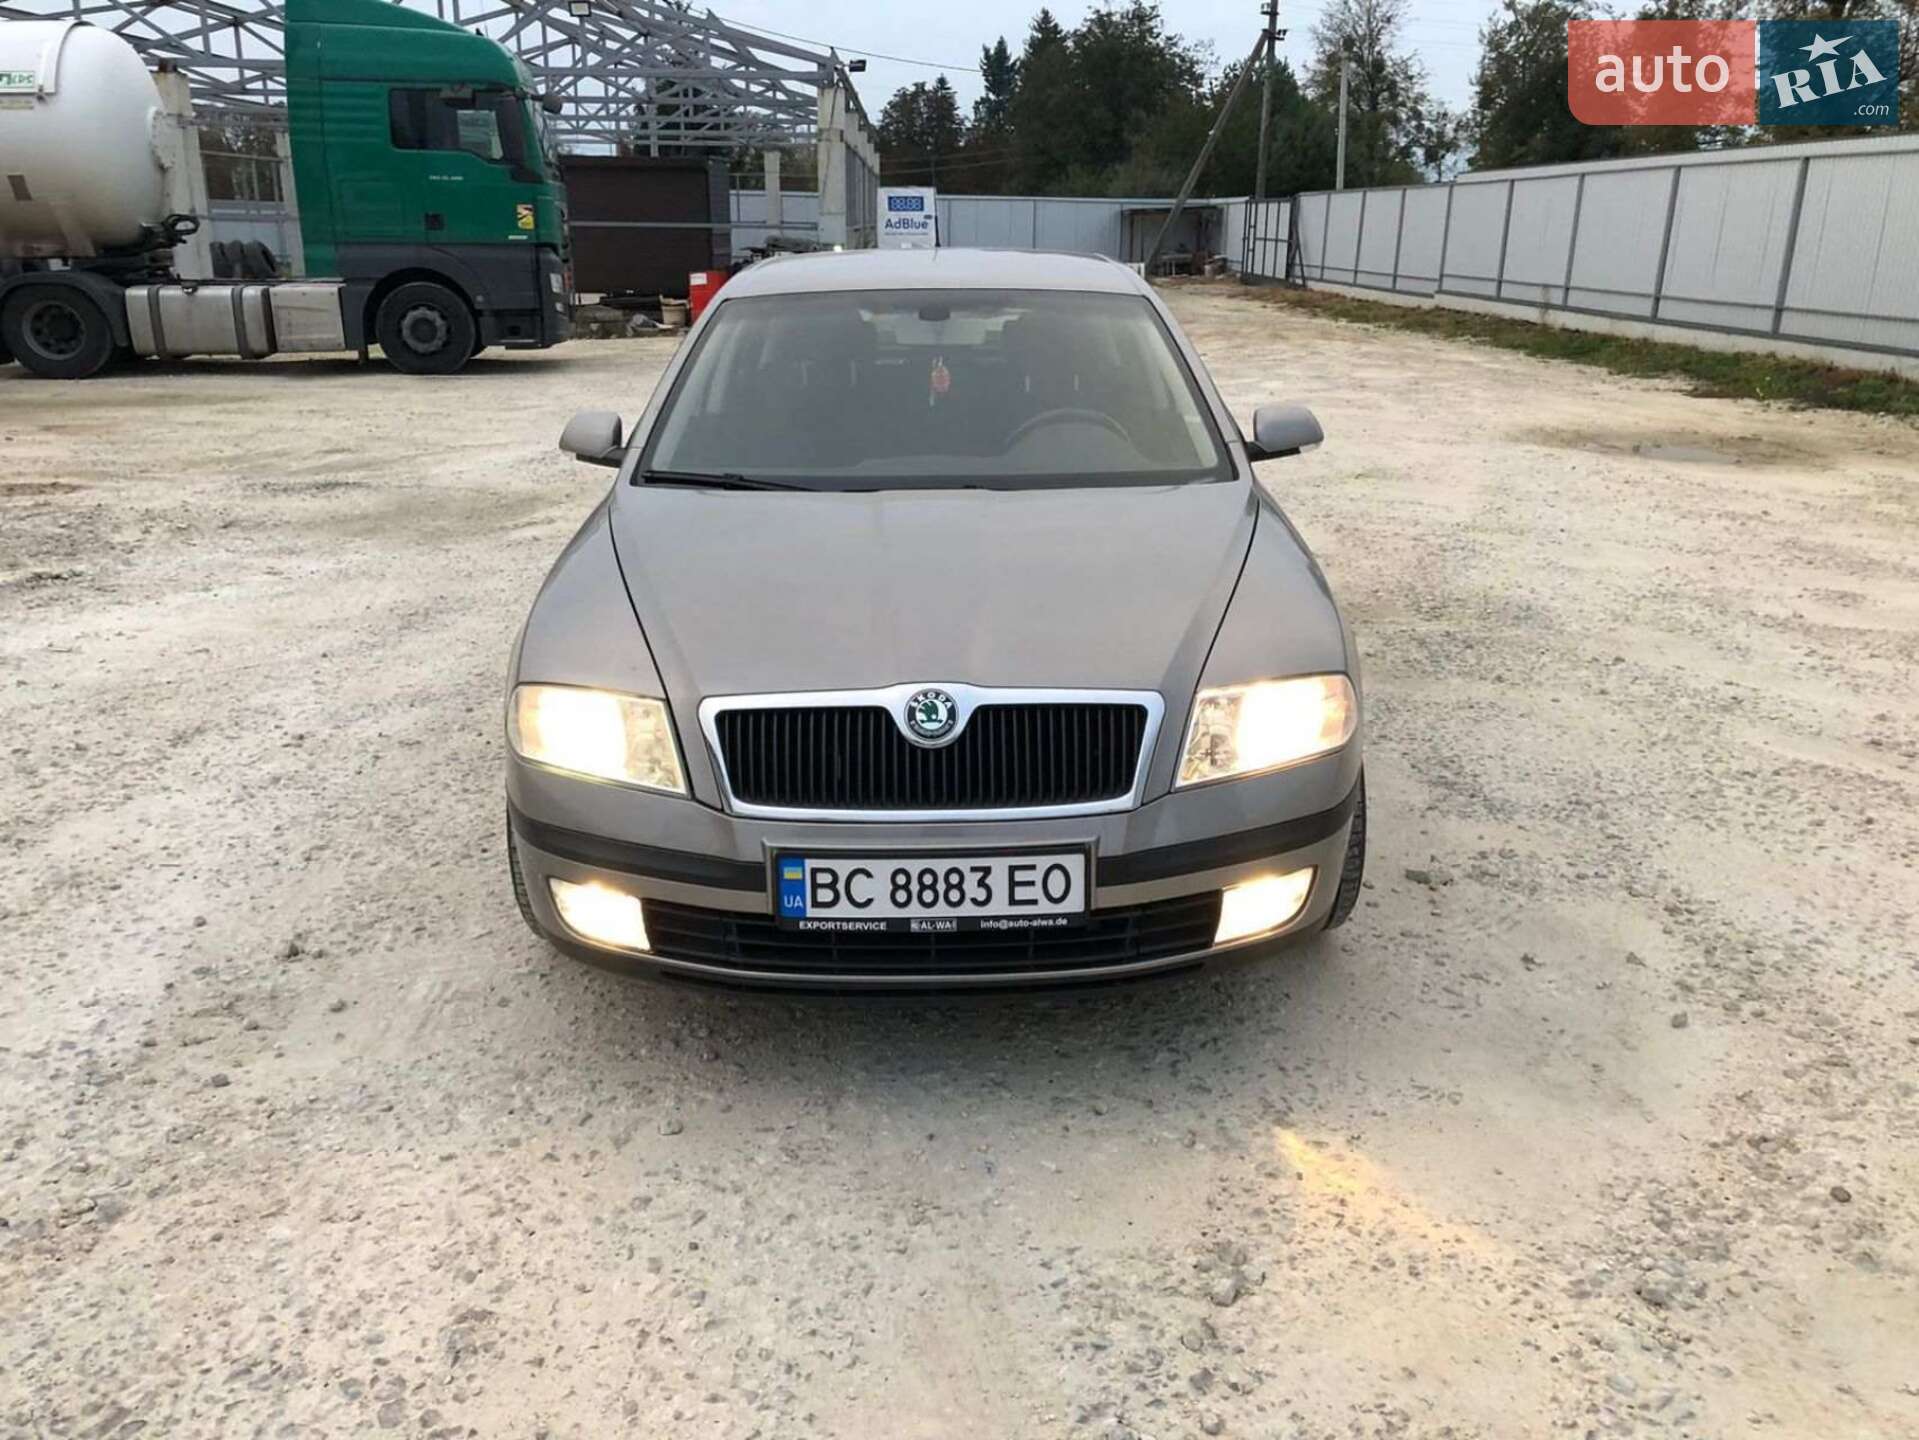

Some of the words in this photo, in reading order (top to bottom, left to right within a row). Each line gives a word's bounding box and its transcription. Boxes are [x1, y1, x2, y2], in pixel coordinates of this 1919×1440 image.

[885, 217, 929, 229] AdBlue
[810, 866, 875, 909] BC
[889, 865, 993, 909] 8883
[1008, 863, 1072, 907] EO
[783, 895, 804, 908] UA
[799, 921, 887, 931] EXPORTSERVICE
